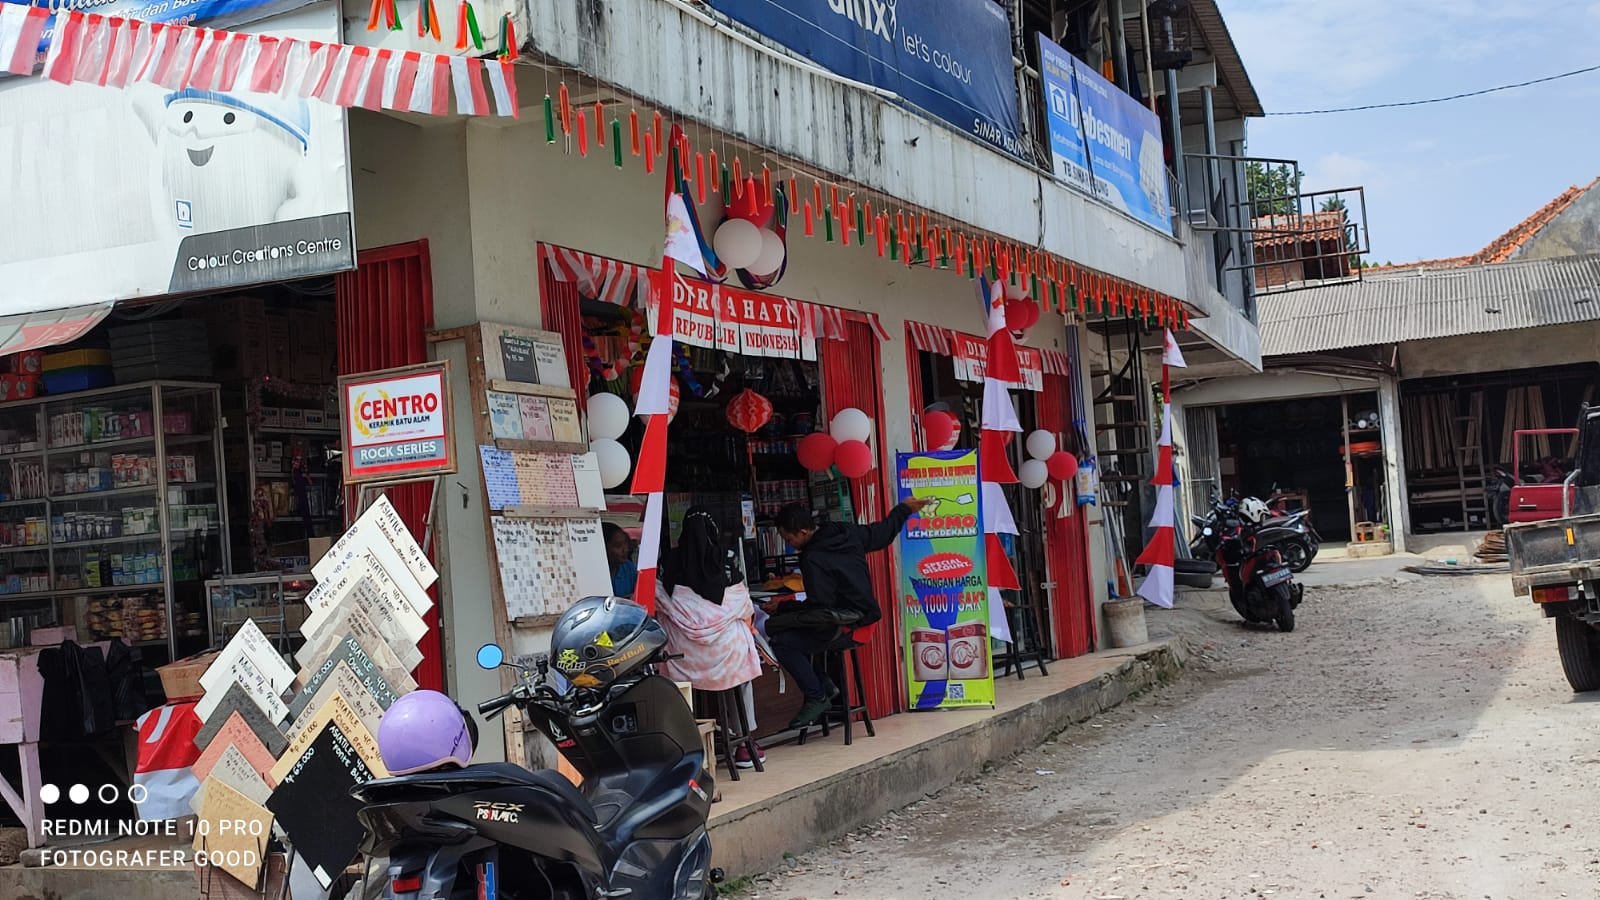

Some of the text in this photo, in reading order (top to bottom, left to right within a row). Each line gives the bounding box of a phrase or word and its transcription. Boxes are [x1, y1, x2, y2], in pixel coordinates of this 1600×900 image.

[140, 3, 168, 20] dan
[901, 27, 972, 86] let's colour
[187, 237, 342, 272] Colour Creations Centre
[744, 331, 799, 352] INDONESIA
[360, 392, 438, 421] CENTRO
[369, 414, 430, 429] KERAMIK BATU ALAM
[361, 446, 394, 461] ROCK
[397, 441, 437, 456] SERIES
[956, 575, 983, 587] HARGA
[924, 593, 948, 614] 1000
[346, 638, 374, 673] ASIATILE
[329, 725, 355, 757] ASIATILE
